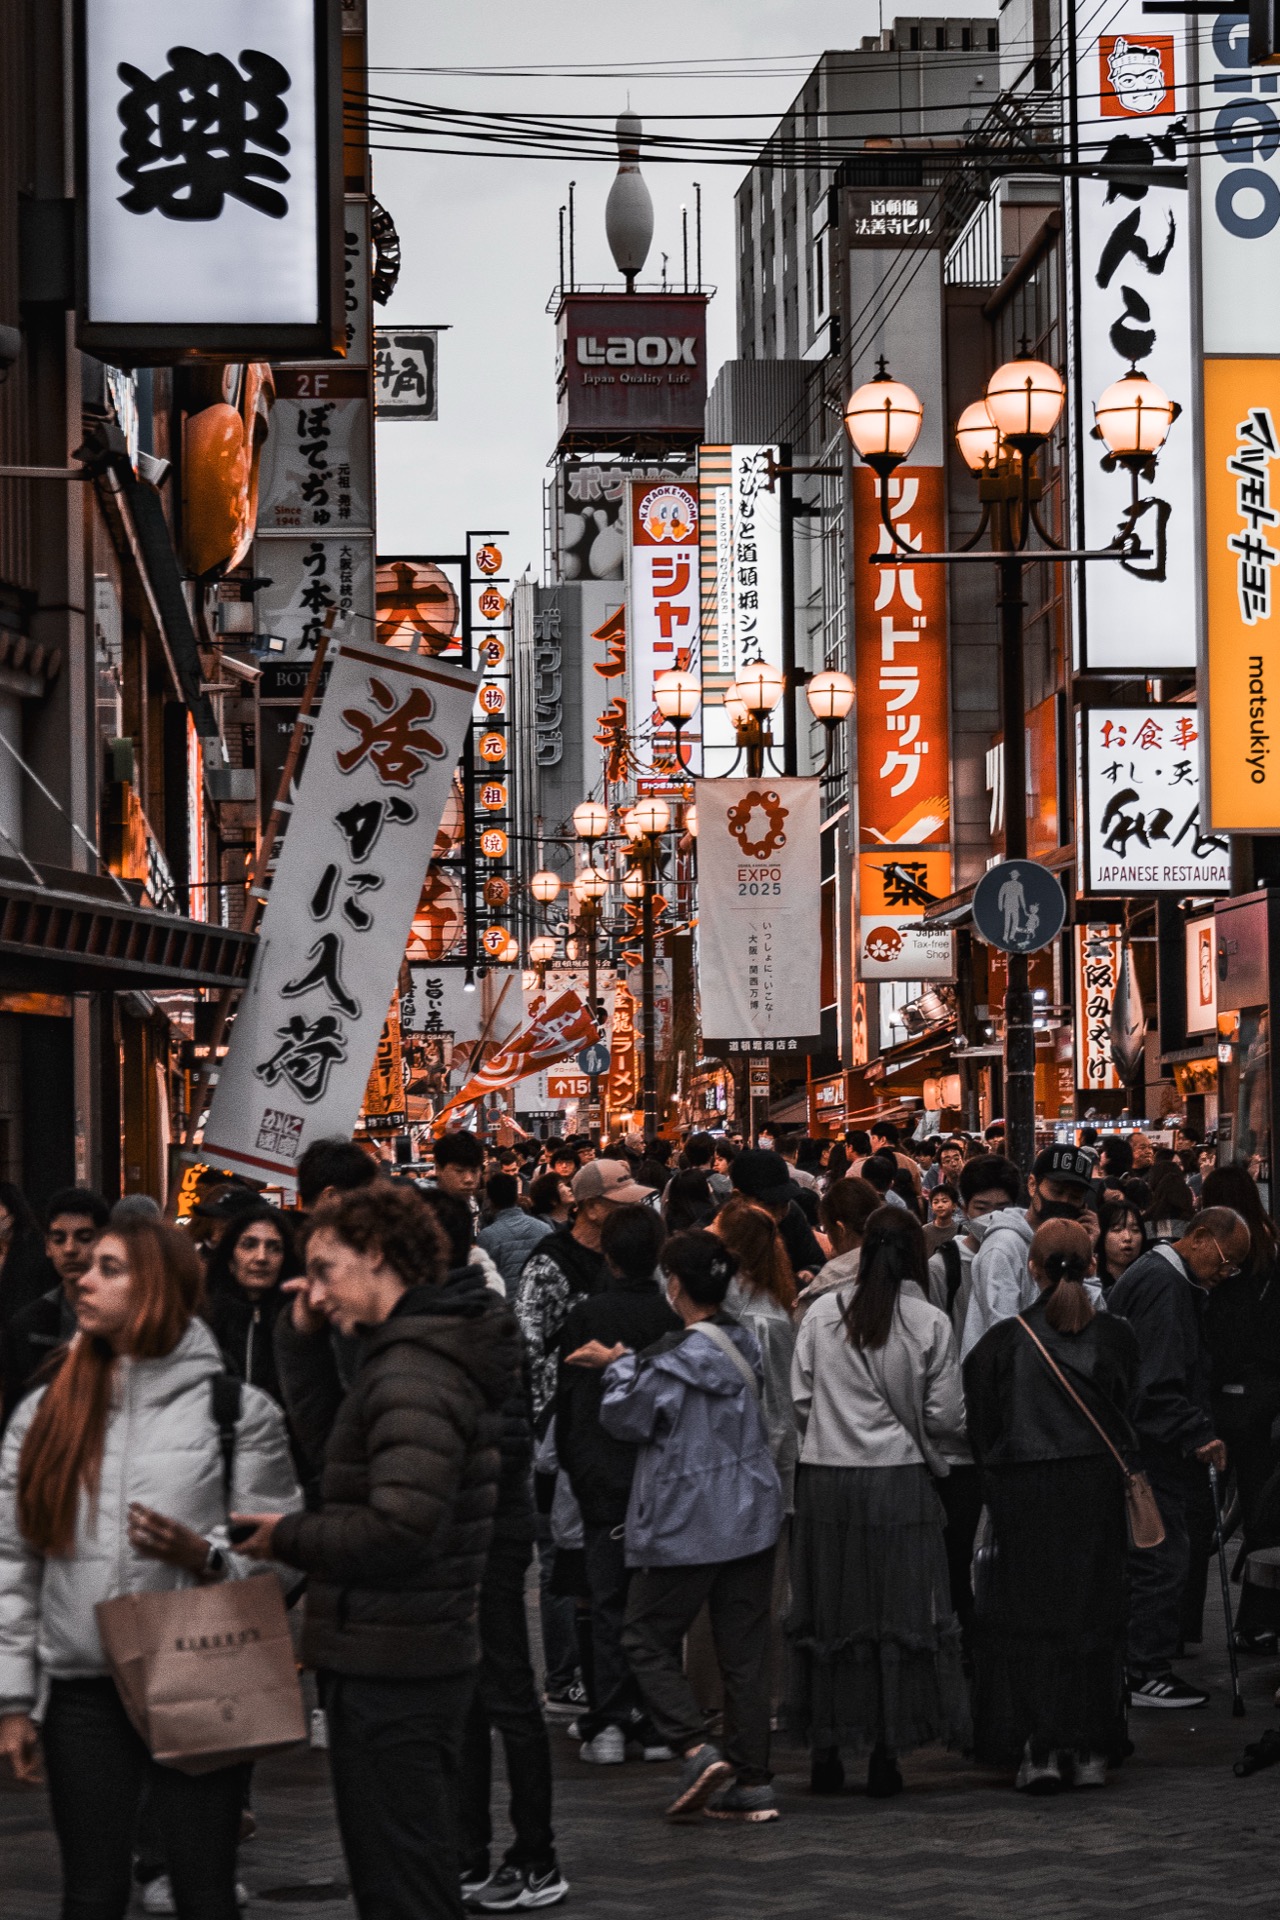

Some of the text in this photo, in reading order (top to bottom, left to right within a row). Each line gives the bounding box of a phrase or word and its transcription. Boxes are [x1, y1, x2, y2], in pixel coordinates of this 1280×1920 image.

[855, 217, 934, 235] 法善寺ビル
[297, 374, 330, 397] 2F
[582, 372, 691, 386] Japan Quality Life
[722, 622, 730, 667] THEATER
[873, 477, 929, 798] ツルハドラッグ
[533, 607, 564, 767] ボウリング
[1246, 655, 1271, 784] matsukiyo
[738, 868, 782, 882] EXPO
[1097, 866, 1159, 882] JAPANESE
[256, 677, 446, 1102] 活かに入荷
[738, 883, 782, 896] 2025
[883, 861, 928, 906] 薬
[912, 940, 950, 949] Tax-free
[926, 950, 950, 960] Shop
[728, 1039, 798, 1051] 道頓堀商店会
